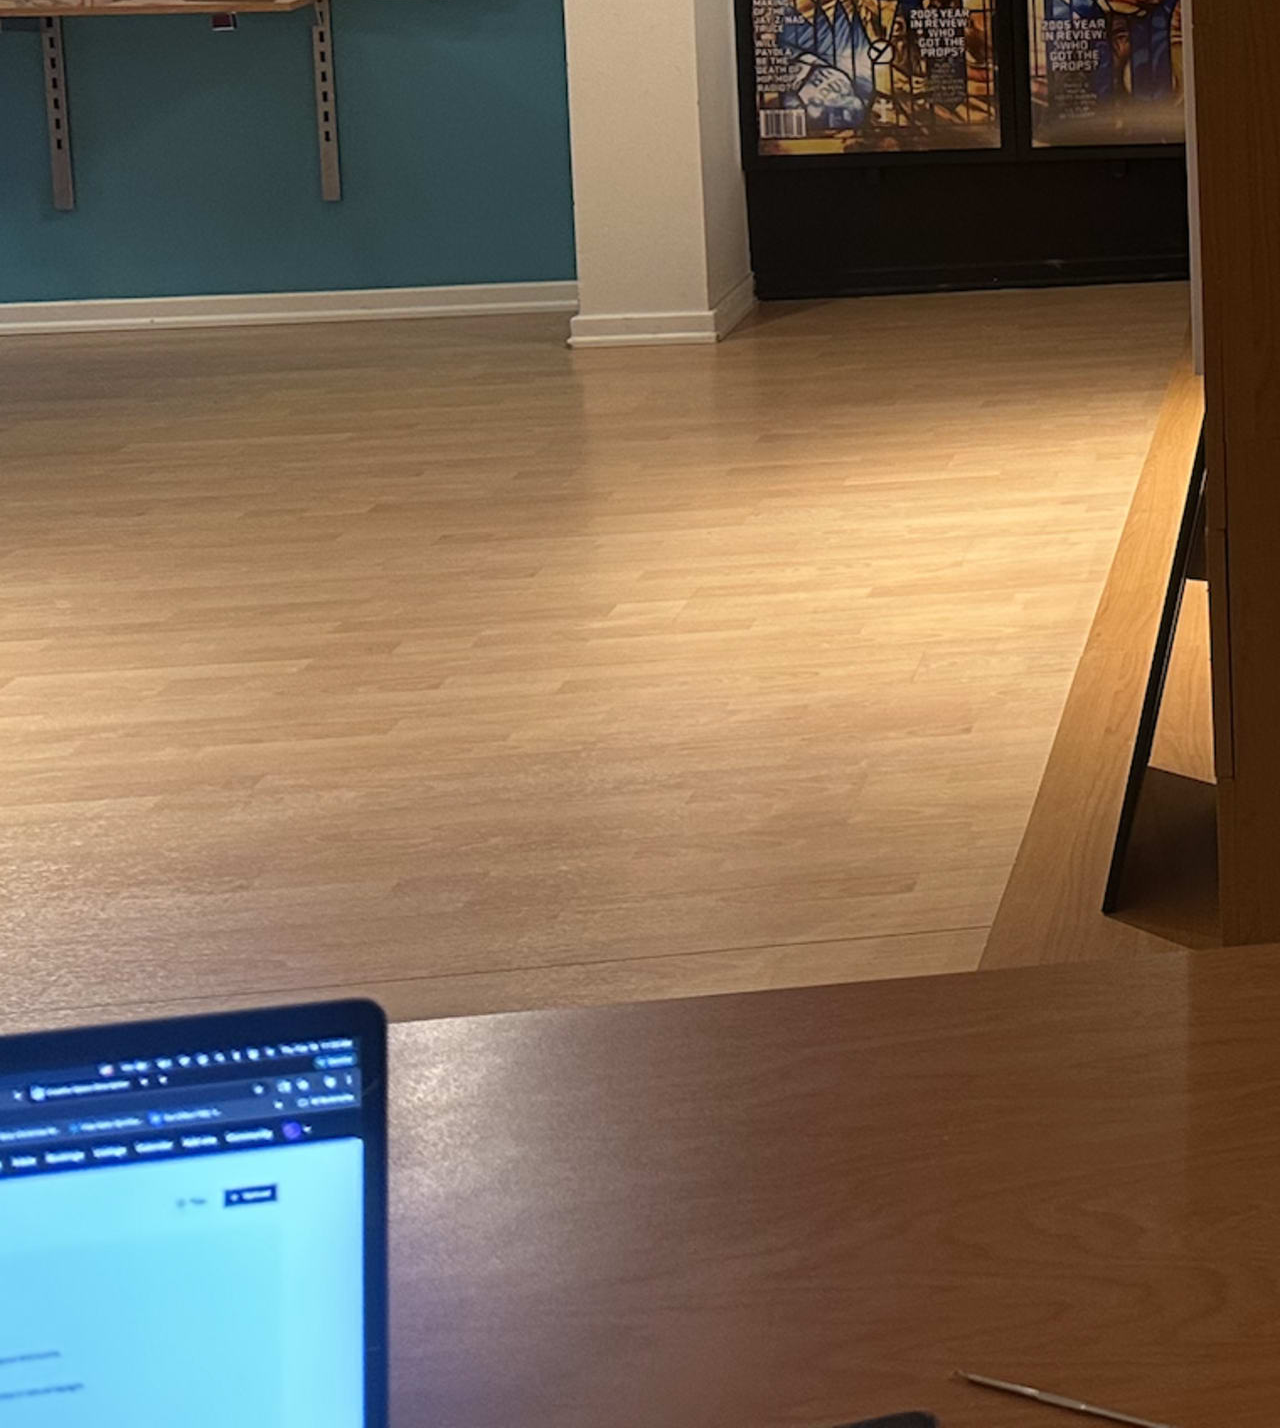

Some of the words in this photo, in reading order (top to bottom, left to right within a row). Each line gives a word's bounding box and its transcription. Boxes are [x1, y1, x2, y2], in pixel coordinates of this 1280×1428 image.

[910, 10, 939, 20] 2005
[940, 9, 969, 19] YEAR
[910, 19, 923, 29] IN
[1041, 20, 1071, 31] 2005
[1074, 19, 1106, 30] YEAR
[928, 28, 956, 37] WHO
[919, 38, 940, 48] GOT
[944, 37, 965, 47] THE
[1059, 40, 1088, 50] WHO
[921, 47, 964, 58] PROPS?
[1049, 51, 1072, 61] GOT
[1078, 50, 1099, 60] THE
[1052, 61, 1098, 72] PROPS?
